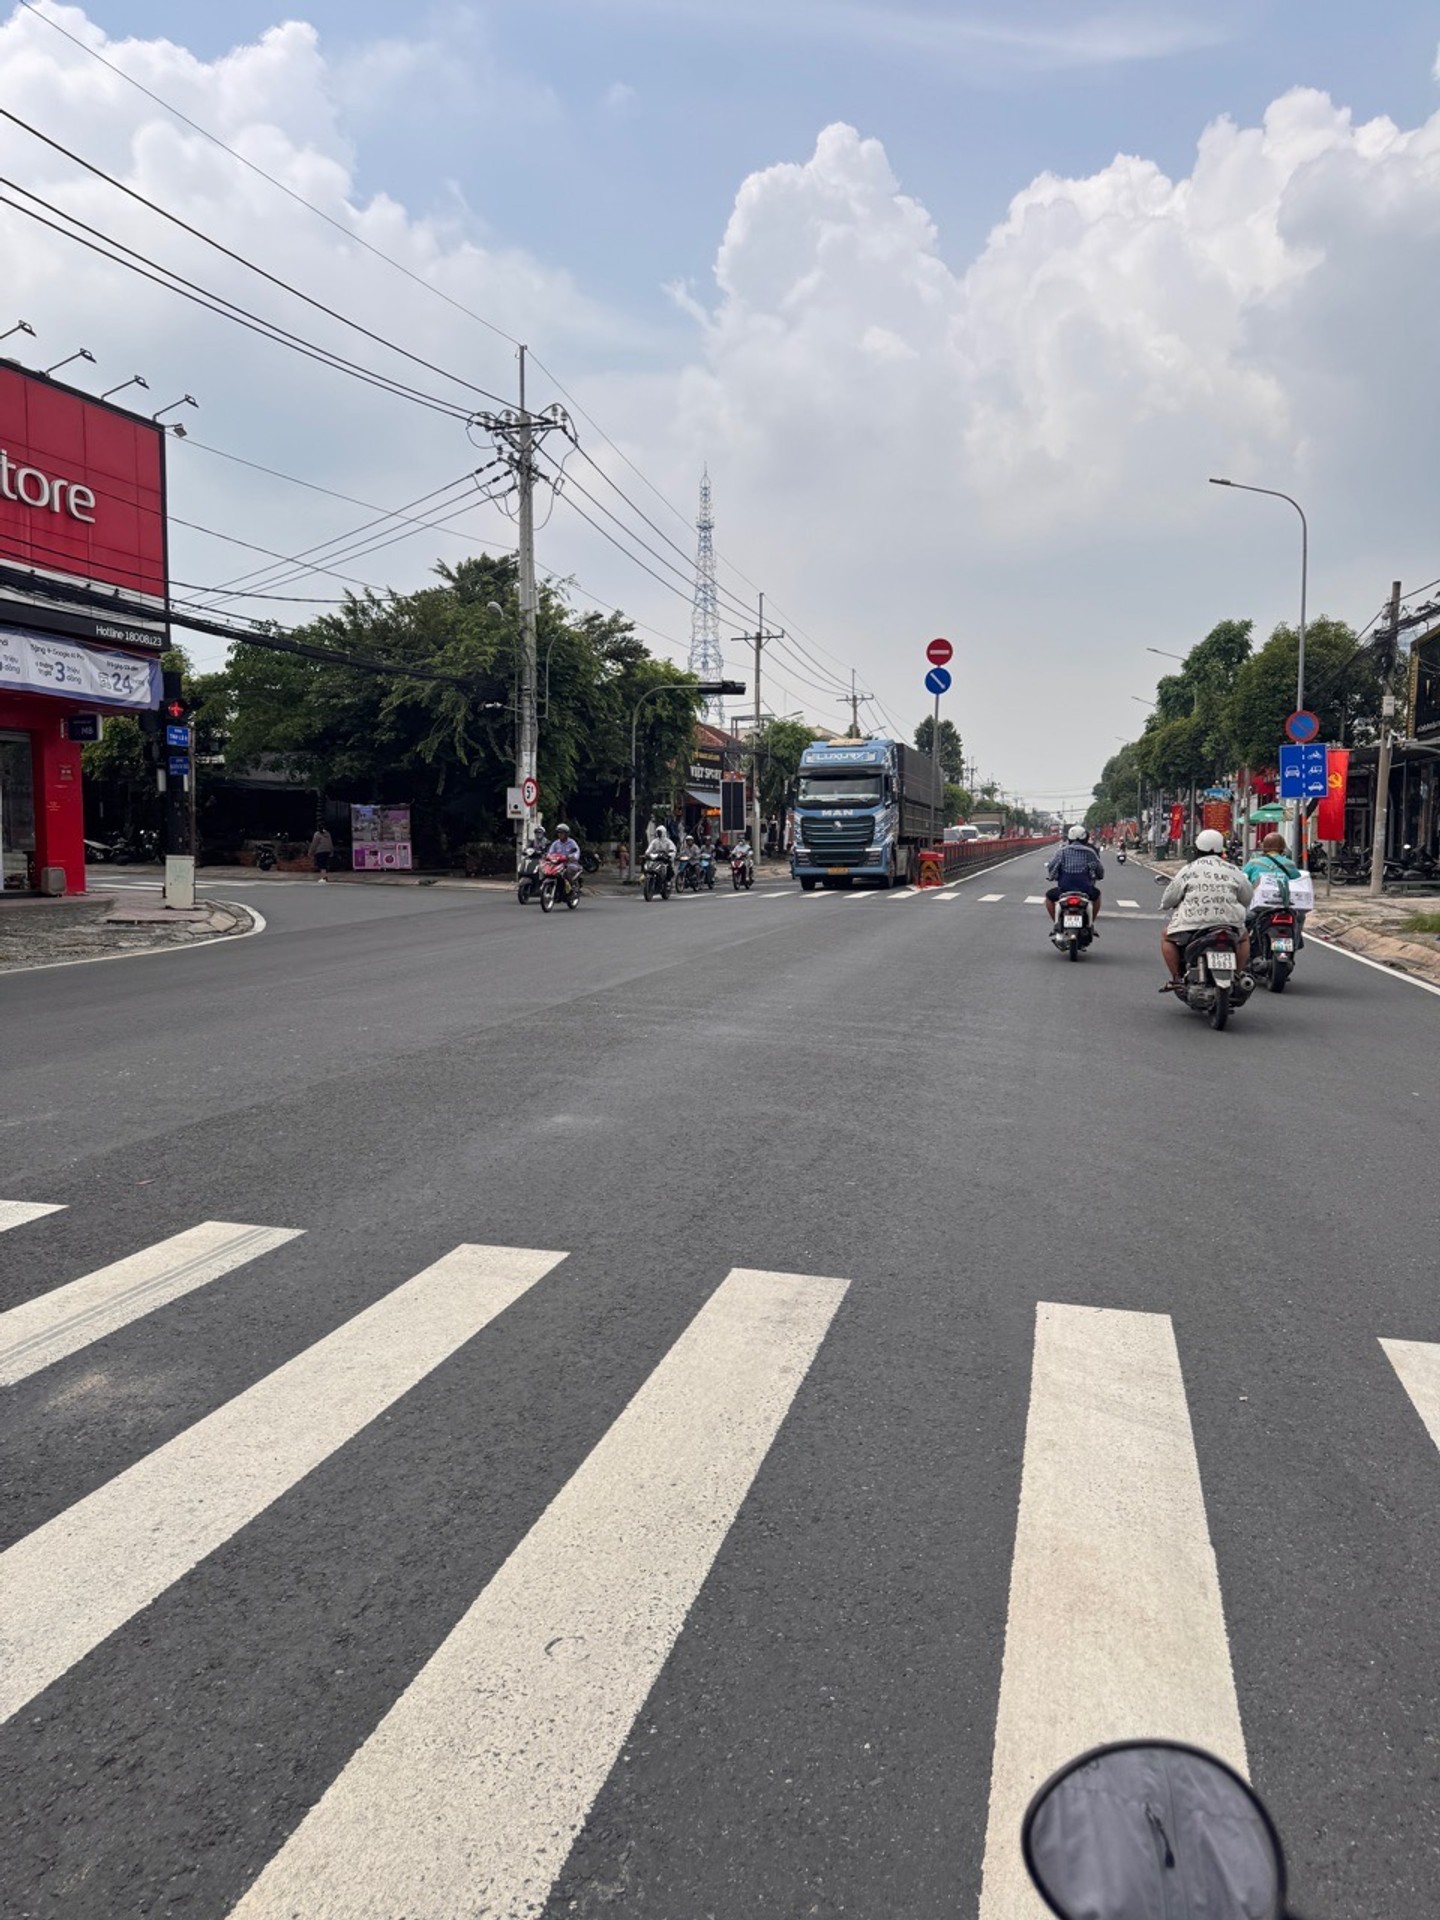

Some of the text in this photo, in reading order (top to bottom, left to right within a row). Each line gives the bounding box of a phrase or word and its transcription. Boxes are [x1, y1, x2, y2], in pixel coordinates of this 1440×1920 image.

[96, 625, 124, 640] Hotline
[54, 661, 66, 682] 3
[111, 672, 133, 694] 24
[816, 752, 864, 761] LUXURY
[1214, 908, 1225, 916] TO
